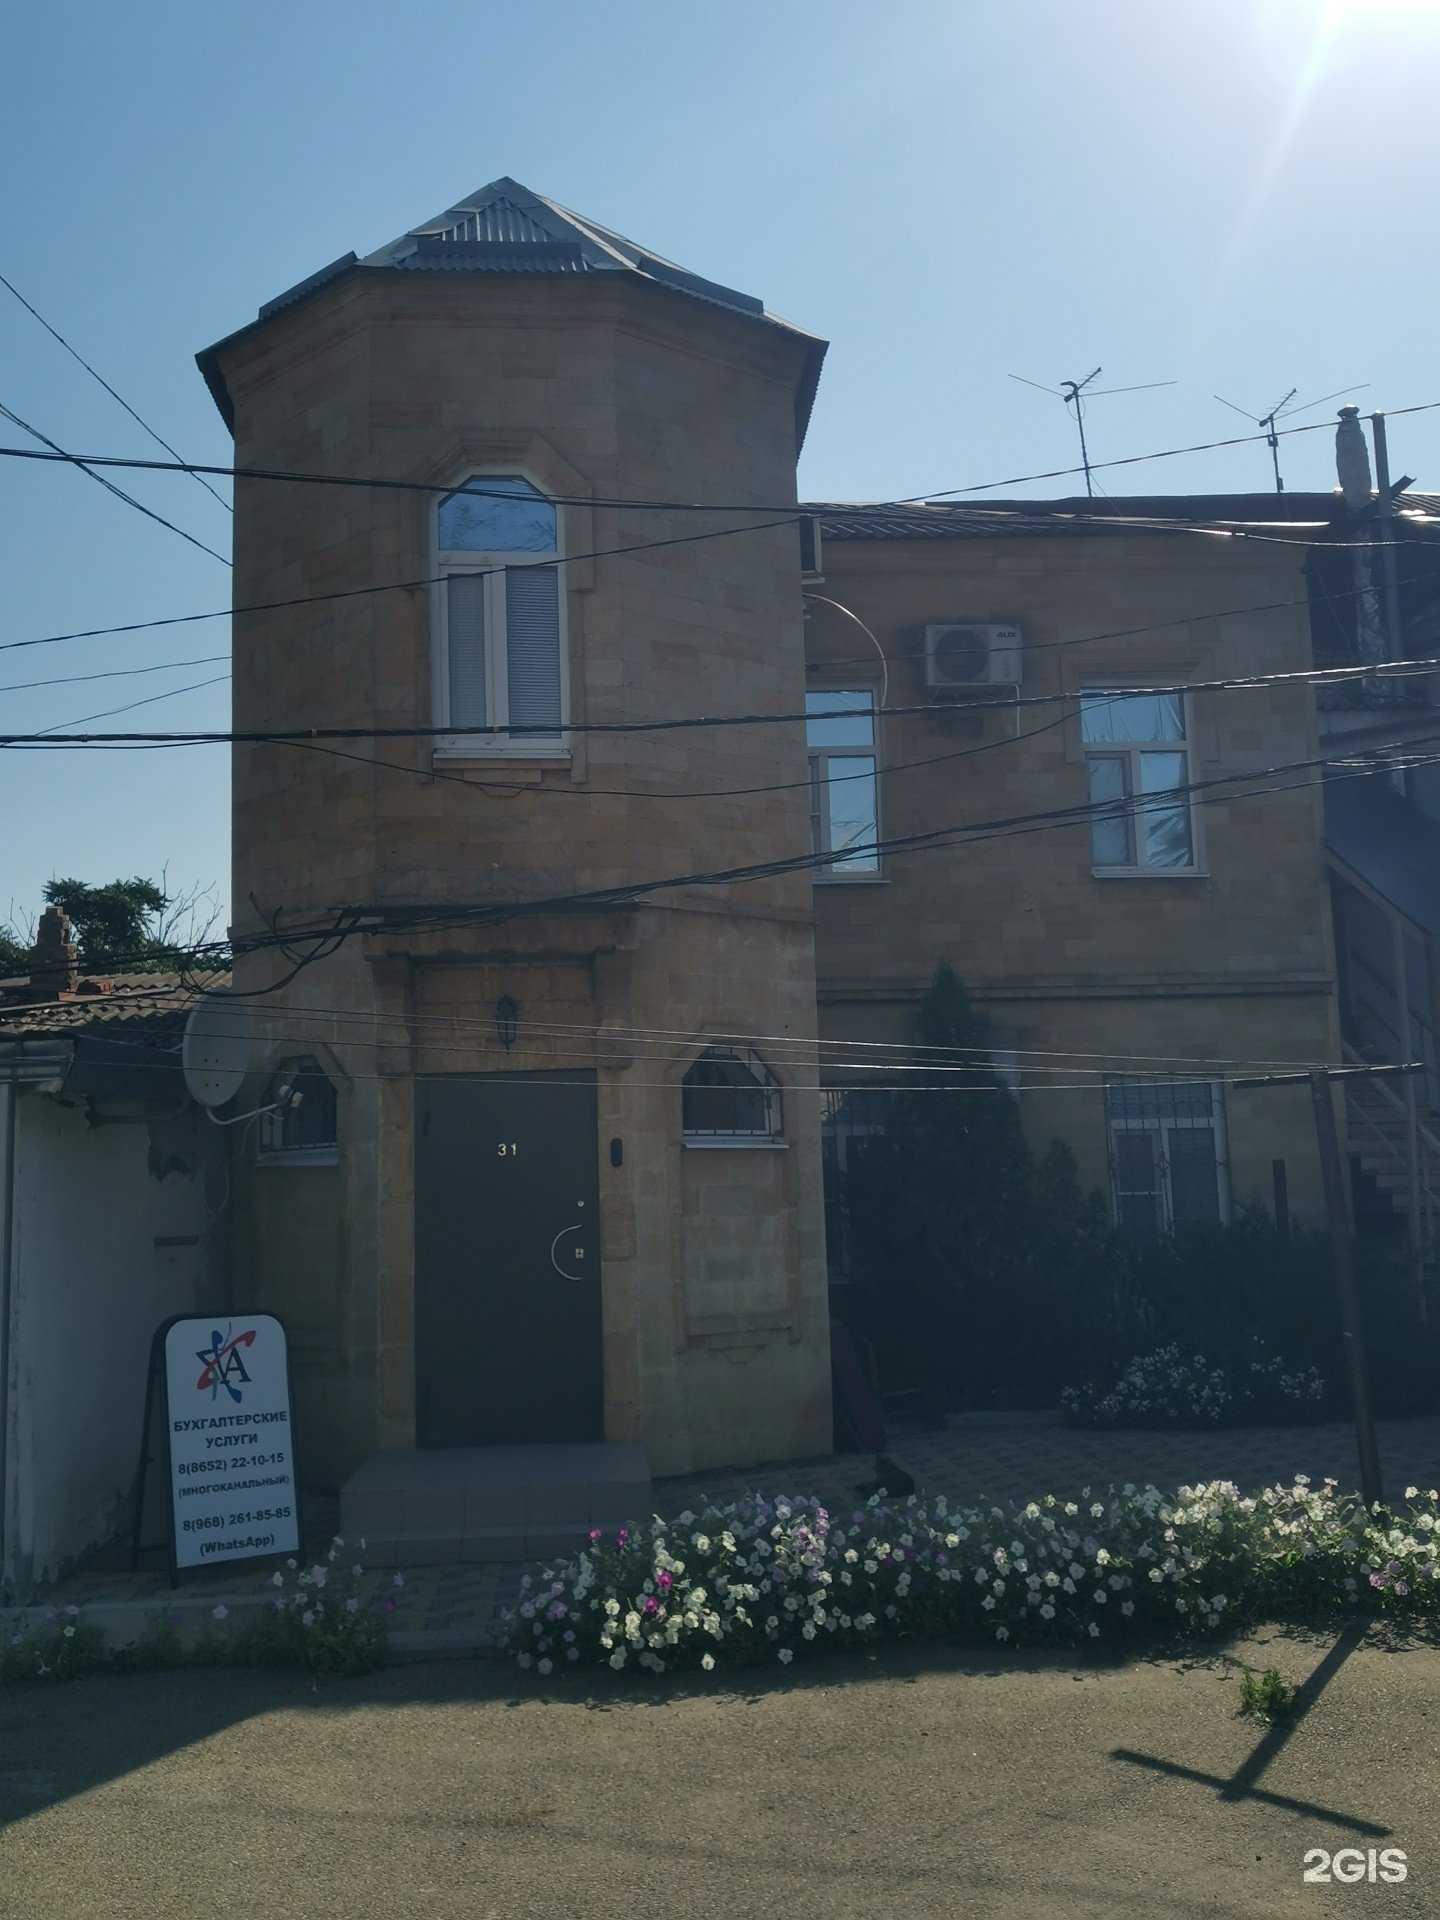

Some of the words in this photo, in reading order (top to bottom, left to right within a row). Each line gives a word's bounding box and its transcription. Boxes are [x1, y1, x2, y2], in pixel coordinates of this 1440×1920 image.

[498, 1143, 516, 1156] 31
[174, 1411, 288, 1432] БУХГАЛТЕРСКИЕ
[206, 1433, 258, 1449] УСЛУГИ
[178, 1459, 228, 1476] 8(8652)
[231, 1452, 285, 1469] 22-10-15
[178, 1475, 290, 1499] (МНОГОКАНАЛЬНЫЙ)
[183, 1515, 225, 1533] 8(968)
[229, 1506, 291, 1526] 261-85-85
[200, 1533, 275, 1557] (WhatsApp)
